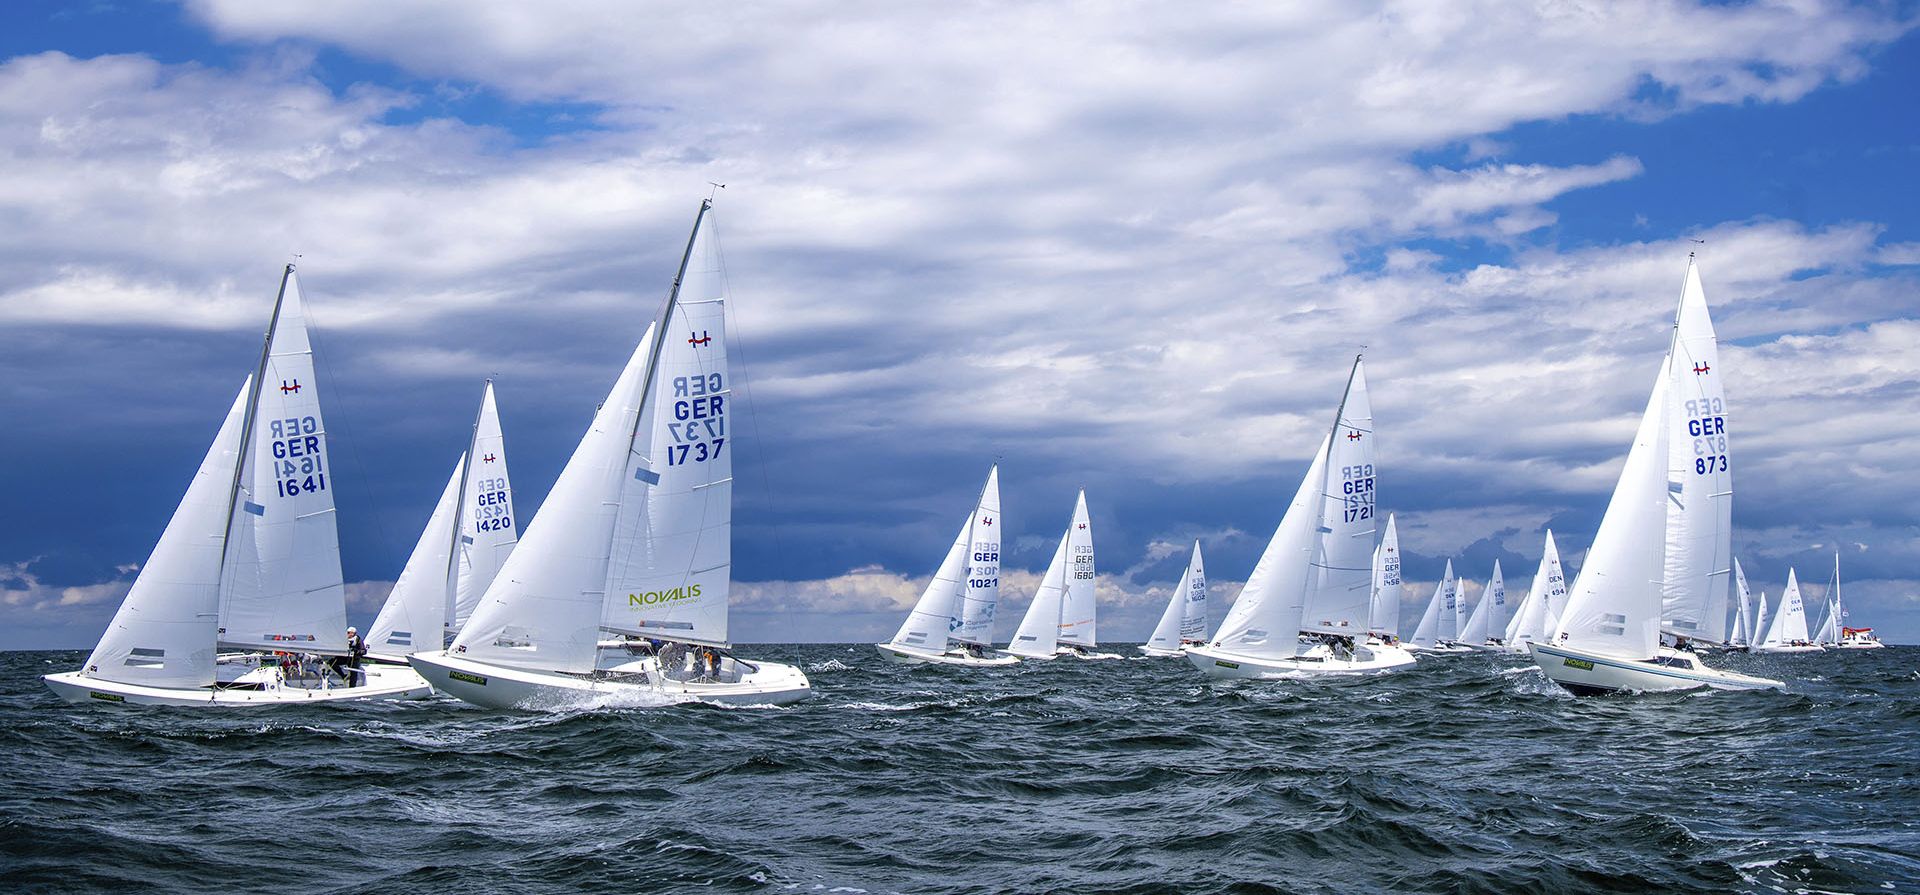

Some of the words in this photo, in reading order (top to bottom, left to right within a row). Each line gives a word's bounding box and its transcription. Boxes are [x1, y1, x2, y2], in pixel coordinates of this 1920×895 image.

[674, 395, 724, 421] GER
[1688, 416, 1725, 437] GER
[272, 435, 320, 459] GER
[667, 438, 725, 466] 1737
[1695, 455, 1728, 475] 873
[277, 473, 326, 498] 1641
[1343, 478, 1374, 495] GER
[478, 491, 507, 507] GER
[1344, 505, 1374, 523] 1721
[476, 516, 511, 534] 1420
[973, 552, 999, 562] GER
[1075, 555, 1093, 564] GER
[1074, 571, 1094, 580] 1680
[1384, 563, 1399, 572] GER
[968, 578, 999, 588] 1021
[1383, 578, 1400, 587] 1456
[628, 584, 702, 607] NOVALIS
